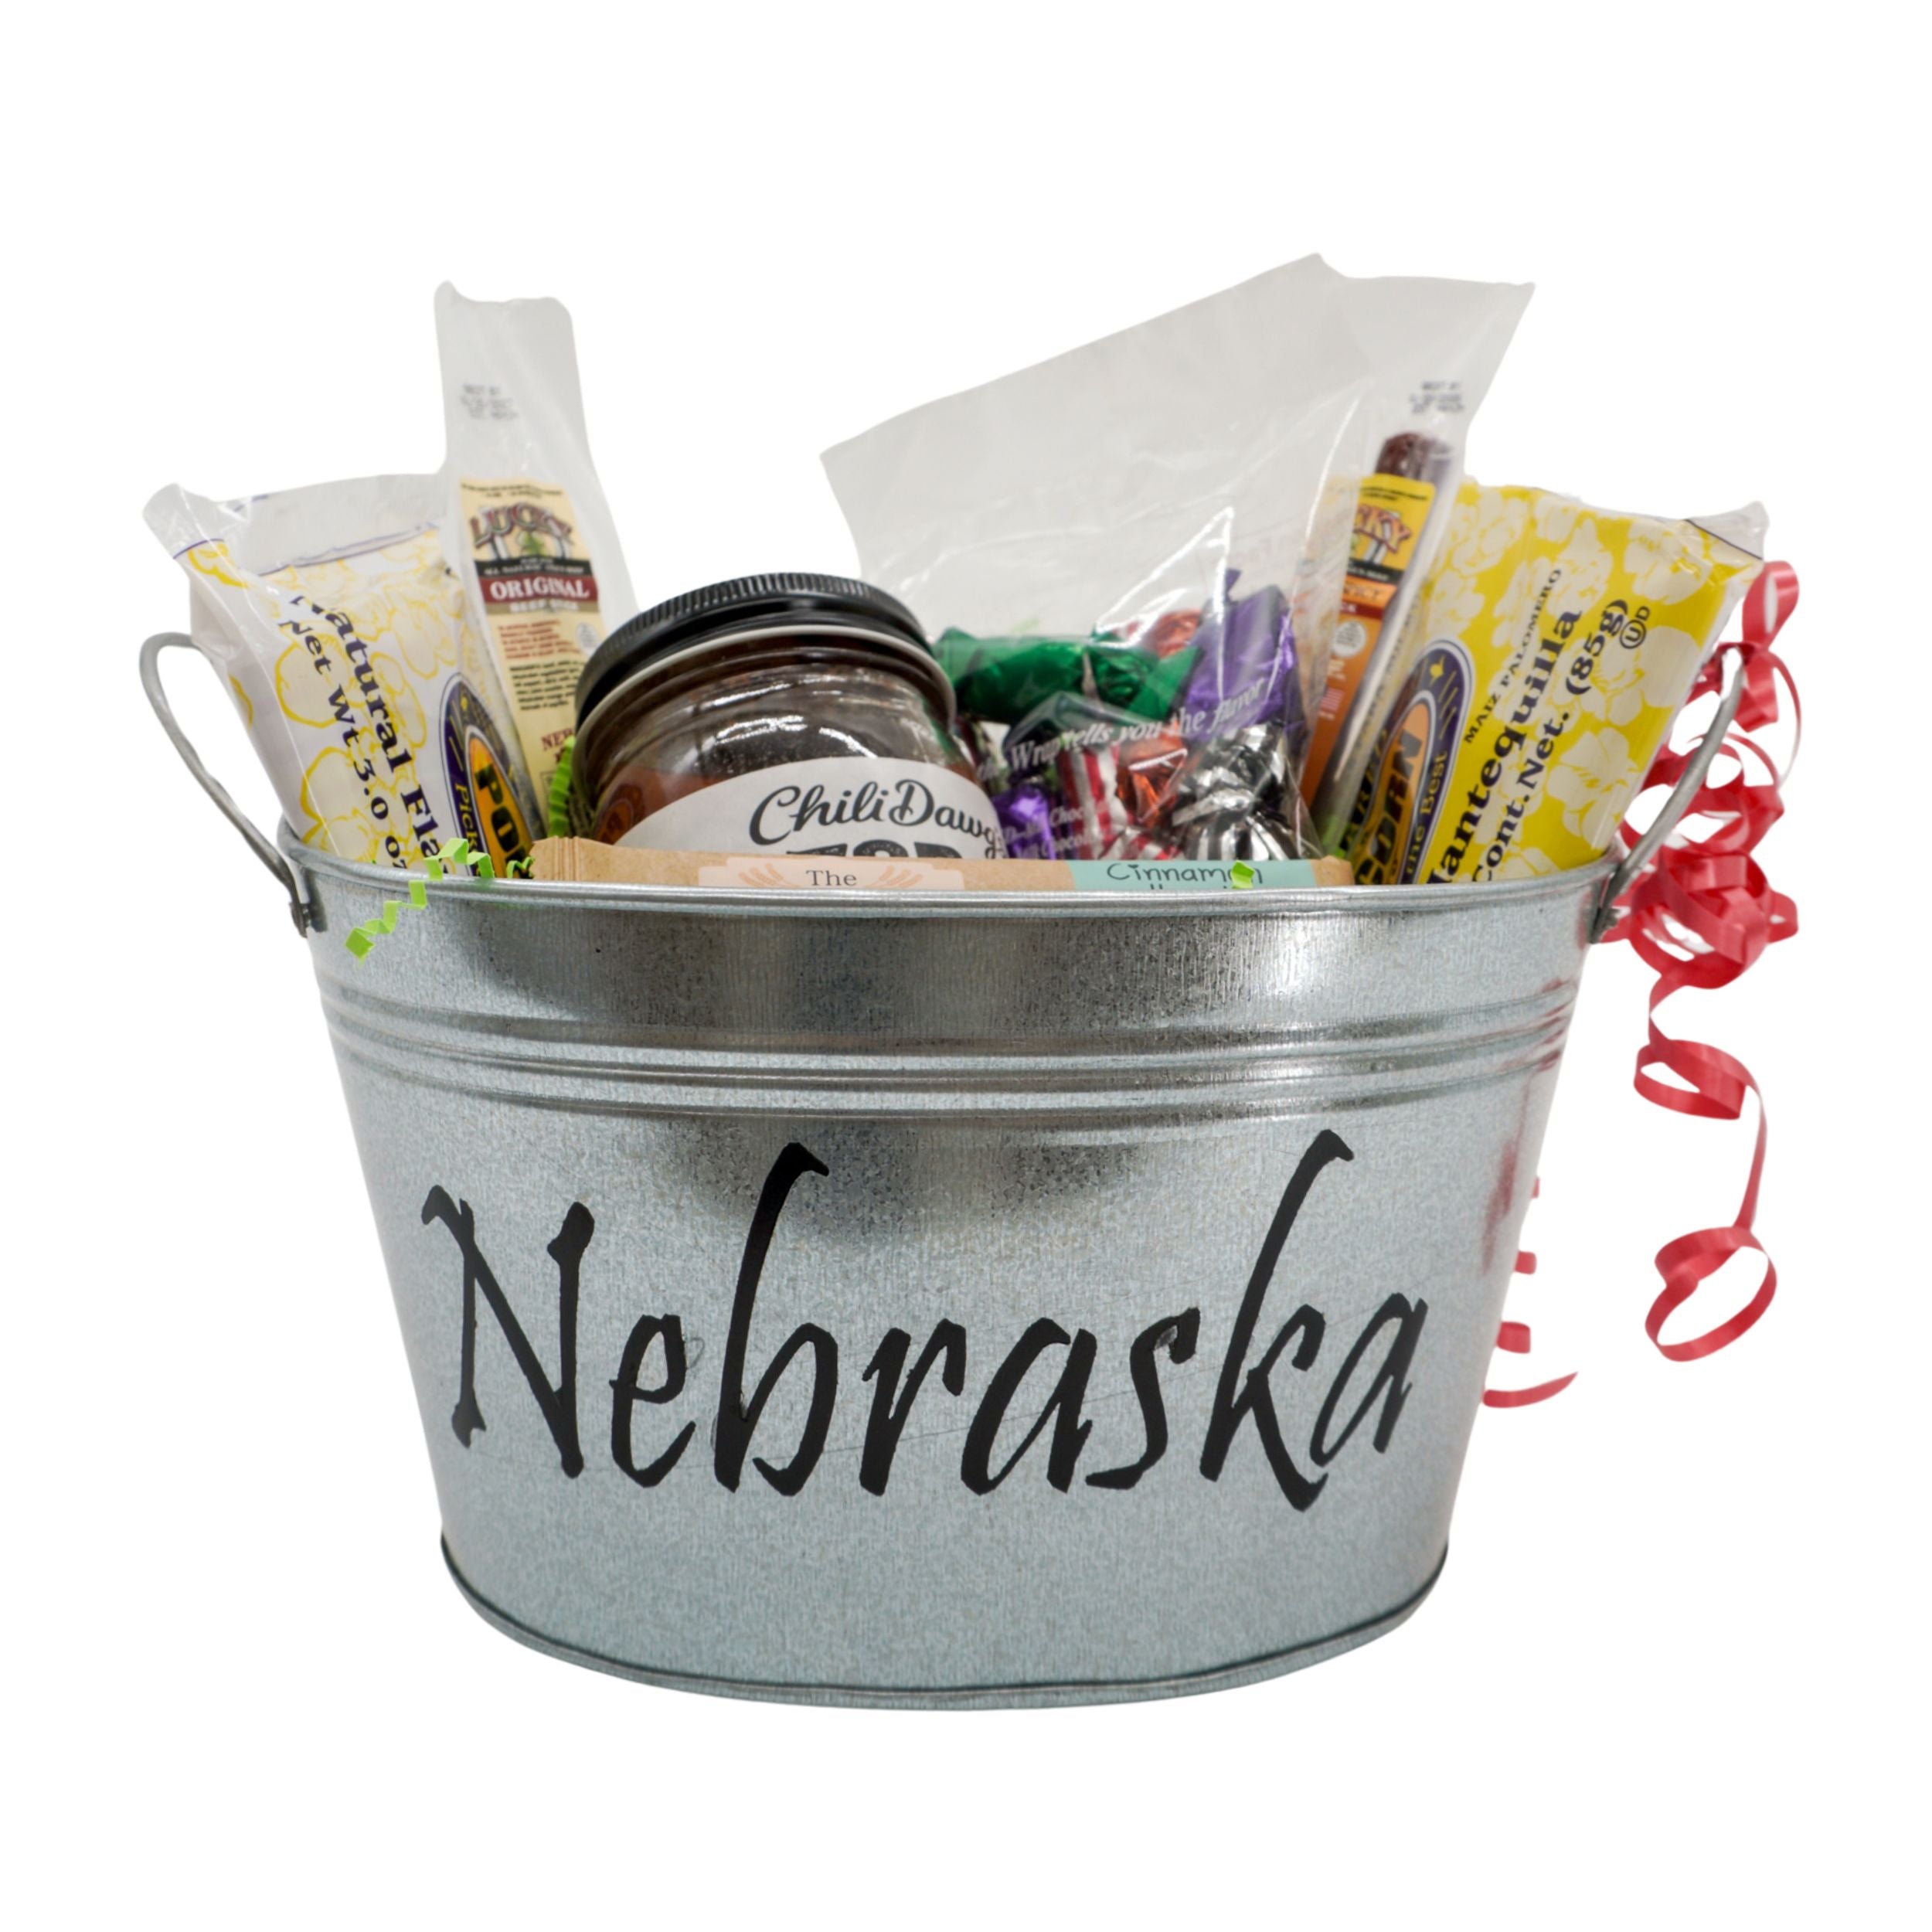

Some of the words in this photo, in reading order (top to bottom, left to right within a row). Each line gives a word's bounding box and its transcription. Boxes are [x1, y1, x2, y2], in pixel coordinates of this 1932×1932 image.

[490, 577, 590, 600] ORIGINAL
[1464, 693, 1501, 743] MAIZ
[1500, 569, 1562, 689] PALOMERO
[1566, 599, 1628, 695] (85g)
[278, 621, 332, 675] Net
[328, 684, 359, 747] Wt
[353, 758, 389, 820] 3.0
[1420, 749, 1448, 815] Best
[400, 784, 449, 874] Fla
[1107, 862, 1264, 884] Cinnamn
[806, 869, 858, 886] The
[422, 1130, 1428, 1511] Nebraska
